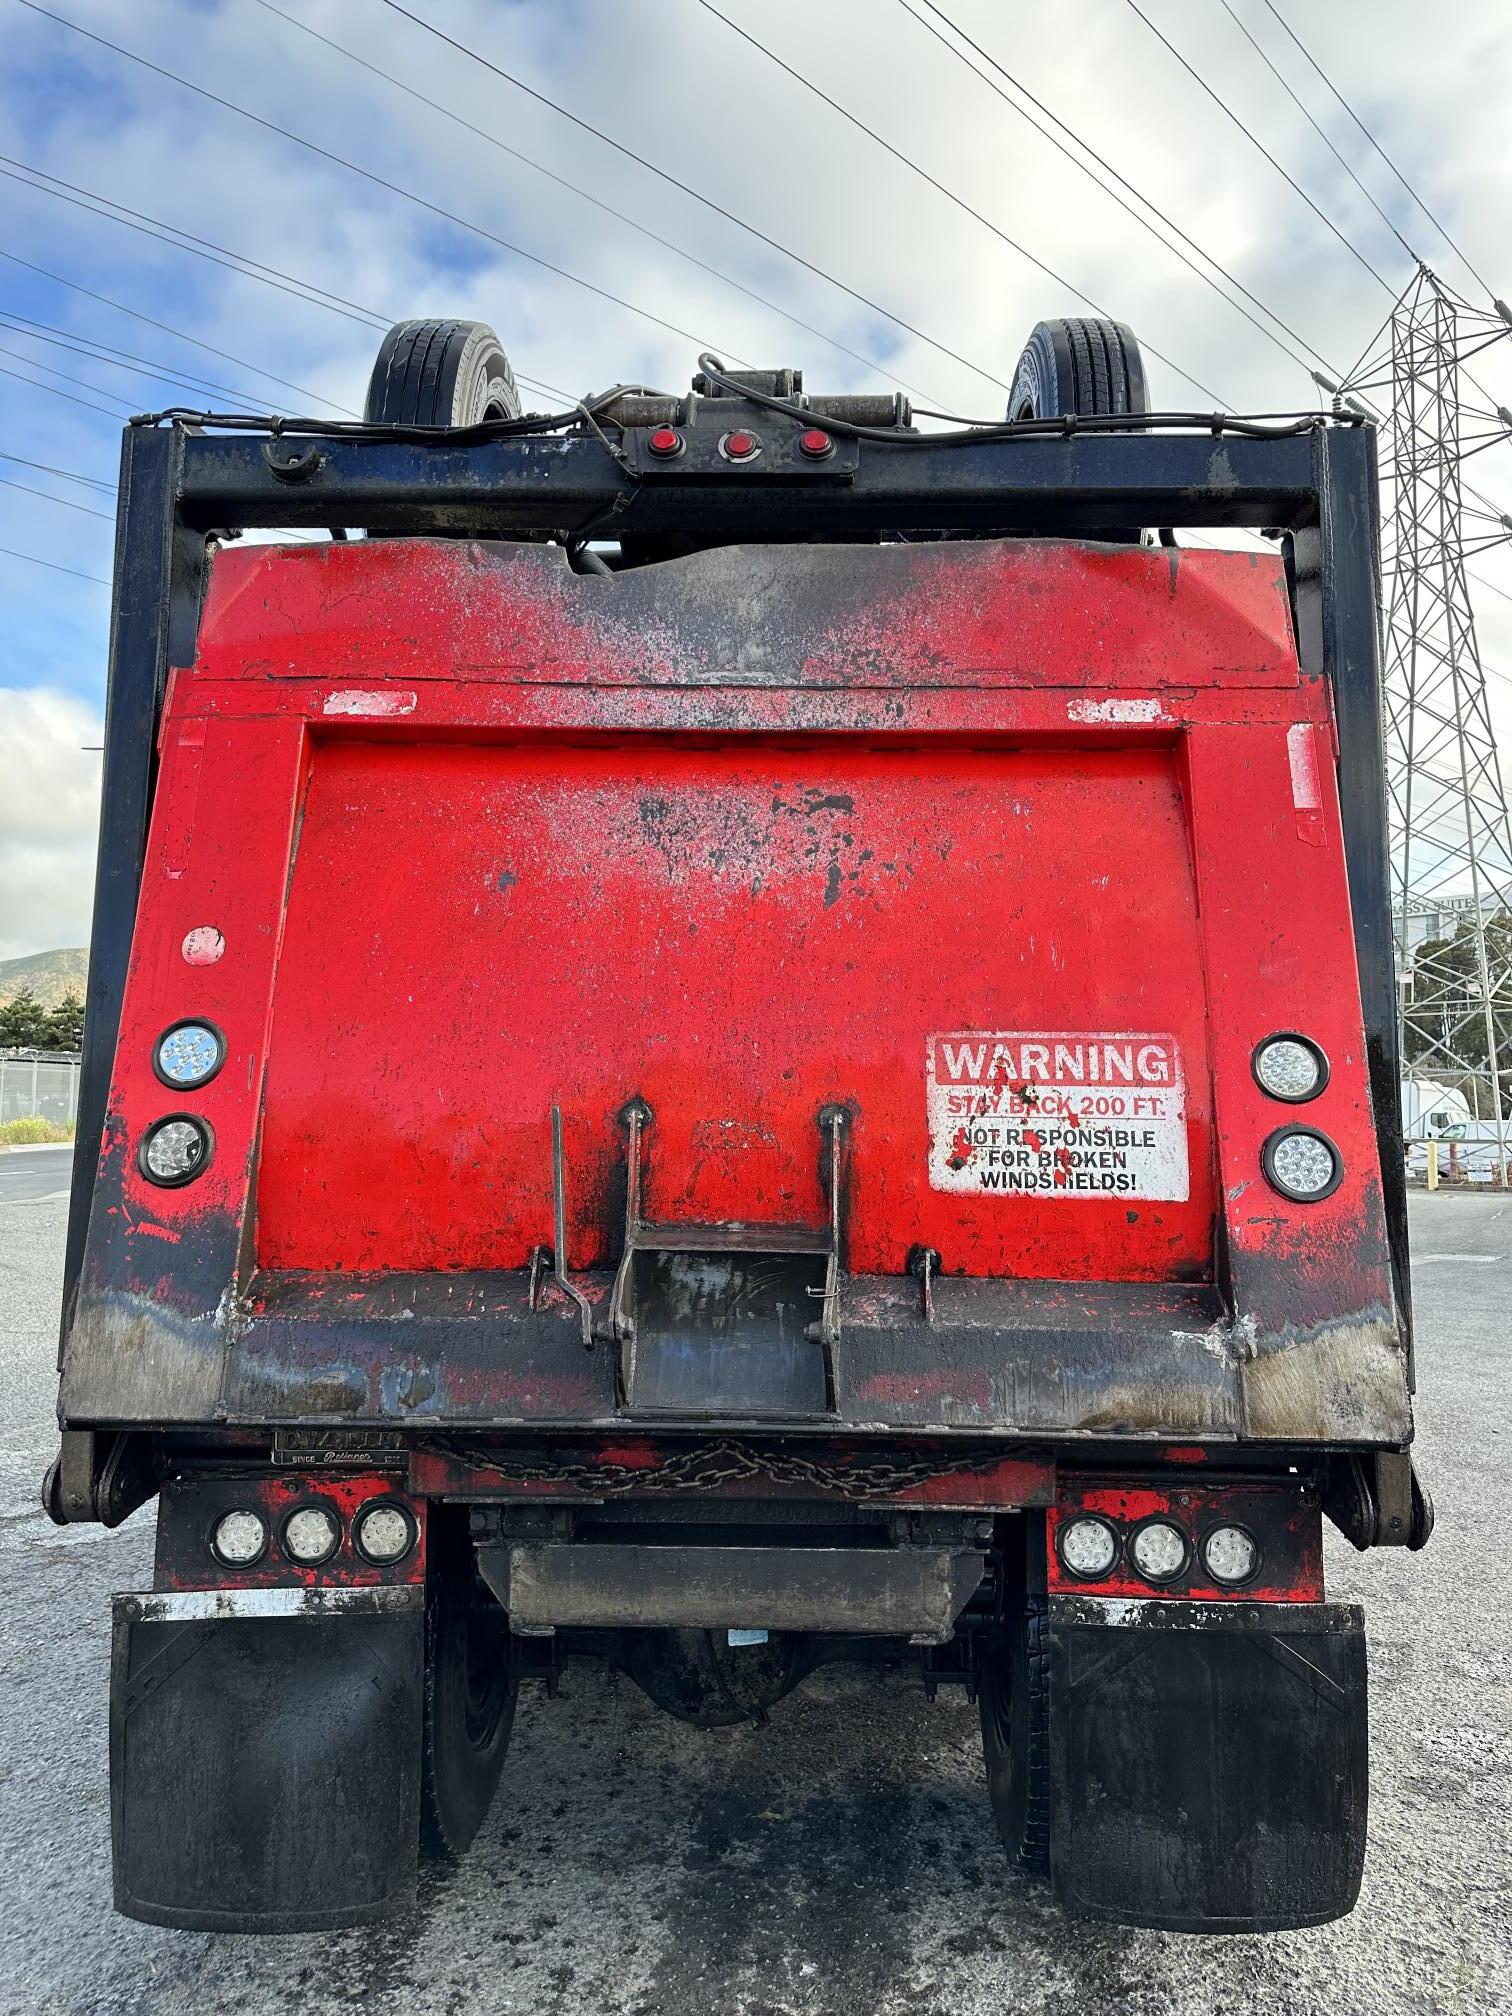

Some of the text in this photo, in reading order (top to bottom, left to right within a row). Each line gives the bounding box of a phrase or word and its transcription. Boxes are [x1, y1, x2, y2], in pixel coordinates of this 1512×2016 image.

[942, 1043, 1169, 1081] WARNING
[947, 1095, 1167, 1116] STAY BACK 200 FT.
[988, 1151, 1030, 1168] FOR
